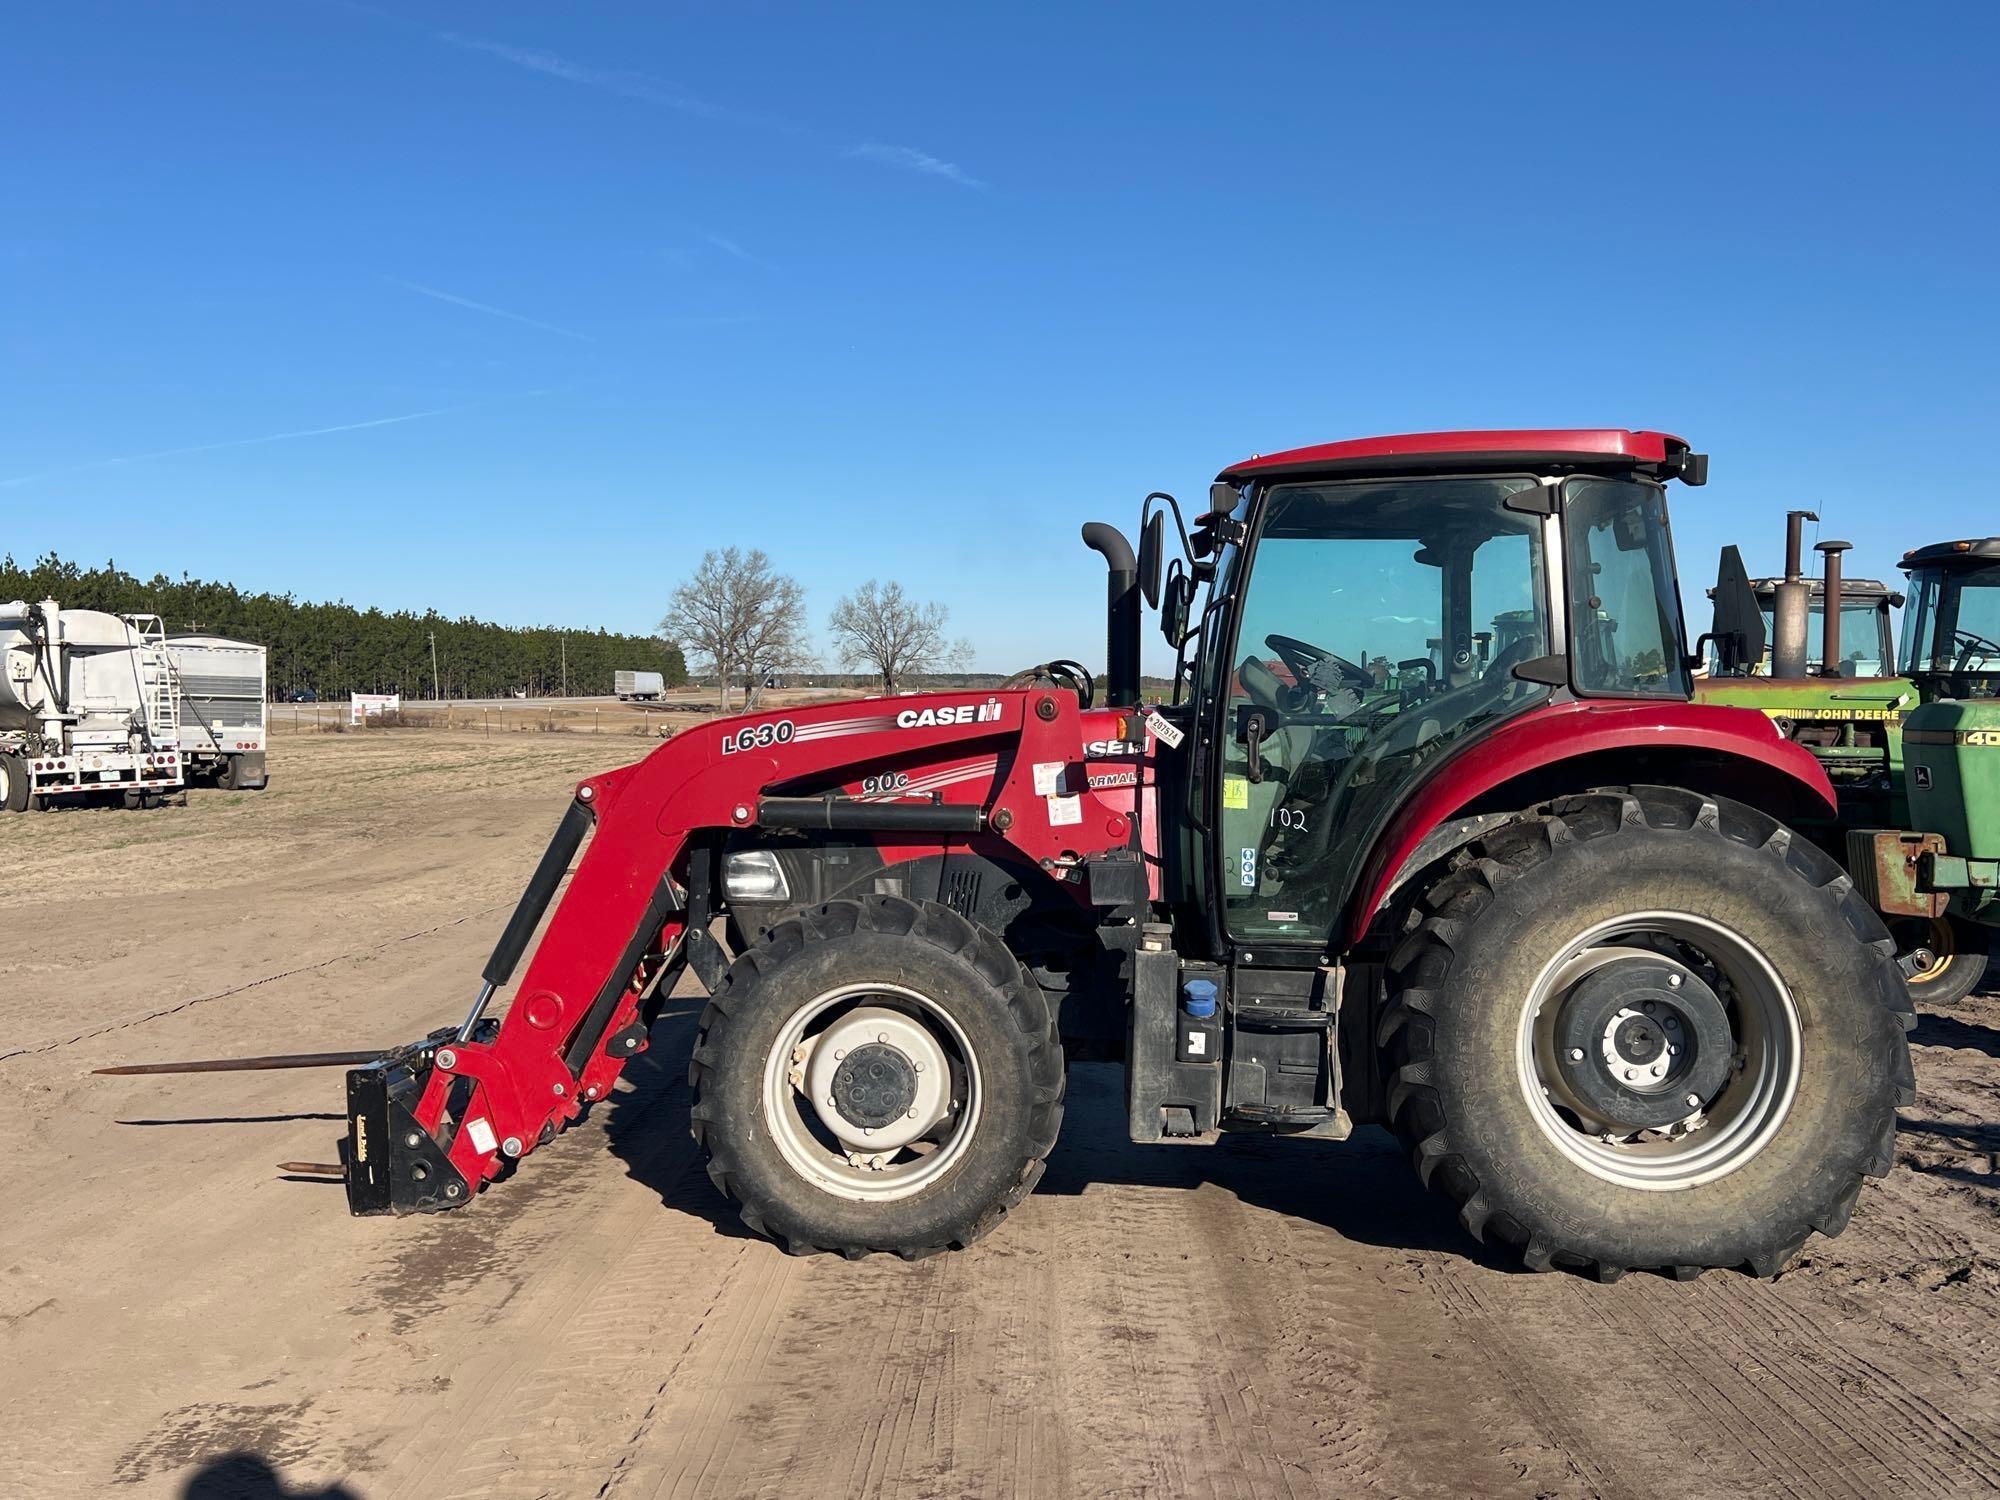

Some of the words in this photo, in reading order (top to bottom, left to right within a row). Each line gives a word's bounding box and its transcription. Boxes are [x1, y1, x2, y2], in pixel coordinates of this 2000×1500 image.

[1815, 710, 1851, 720] JOHN
[1855, 710, 1899, 720] DEERE
[722, 720, 795, 755] L630
[896, 706, 975, 729] CASE
[1153, 718, 1178, 740] 207574
[1087, 772, 1145, 788] ARMALL
[1270, 807, 1309, 833] 102
